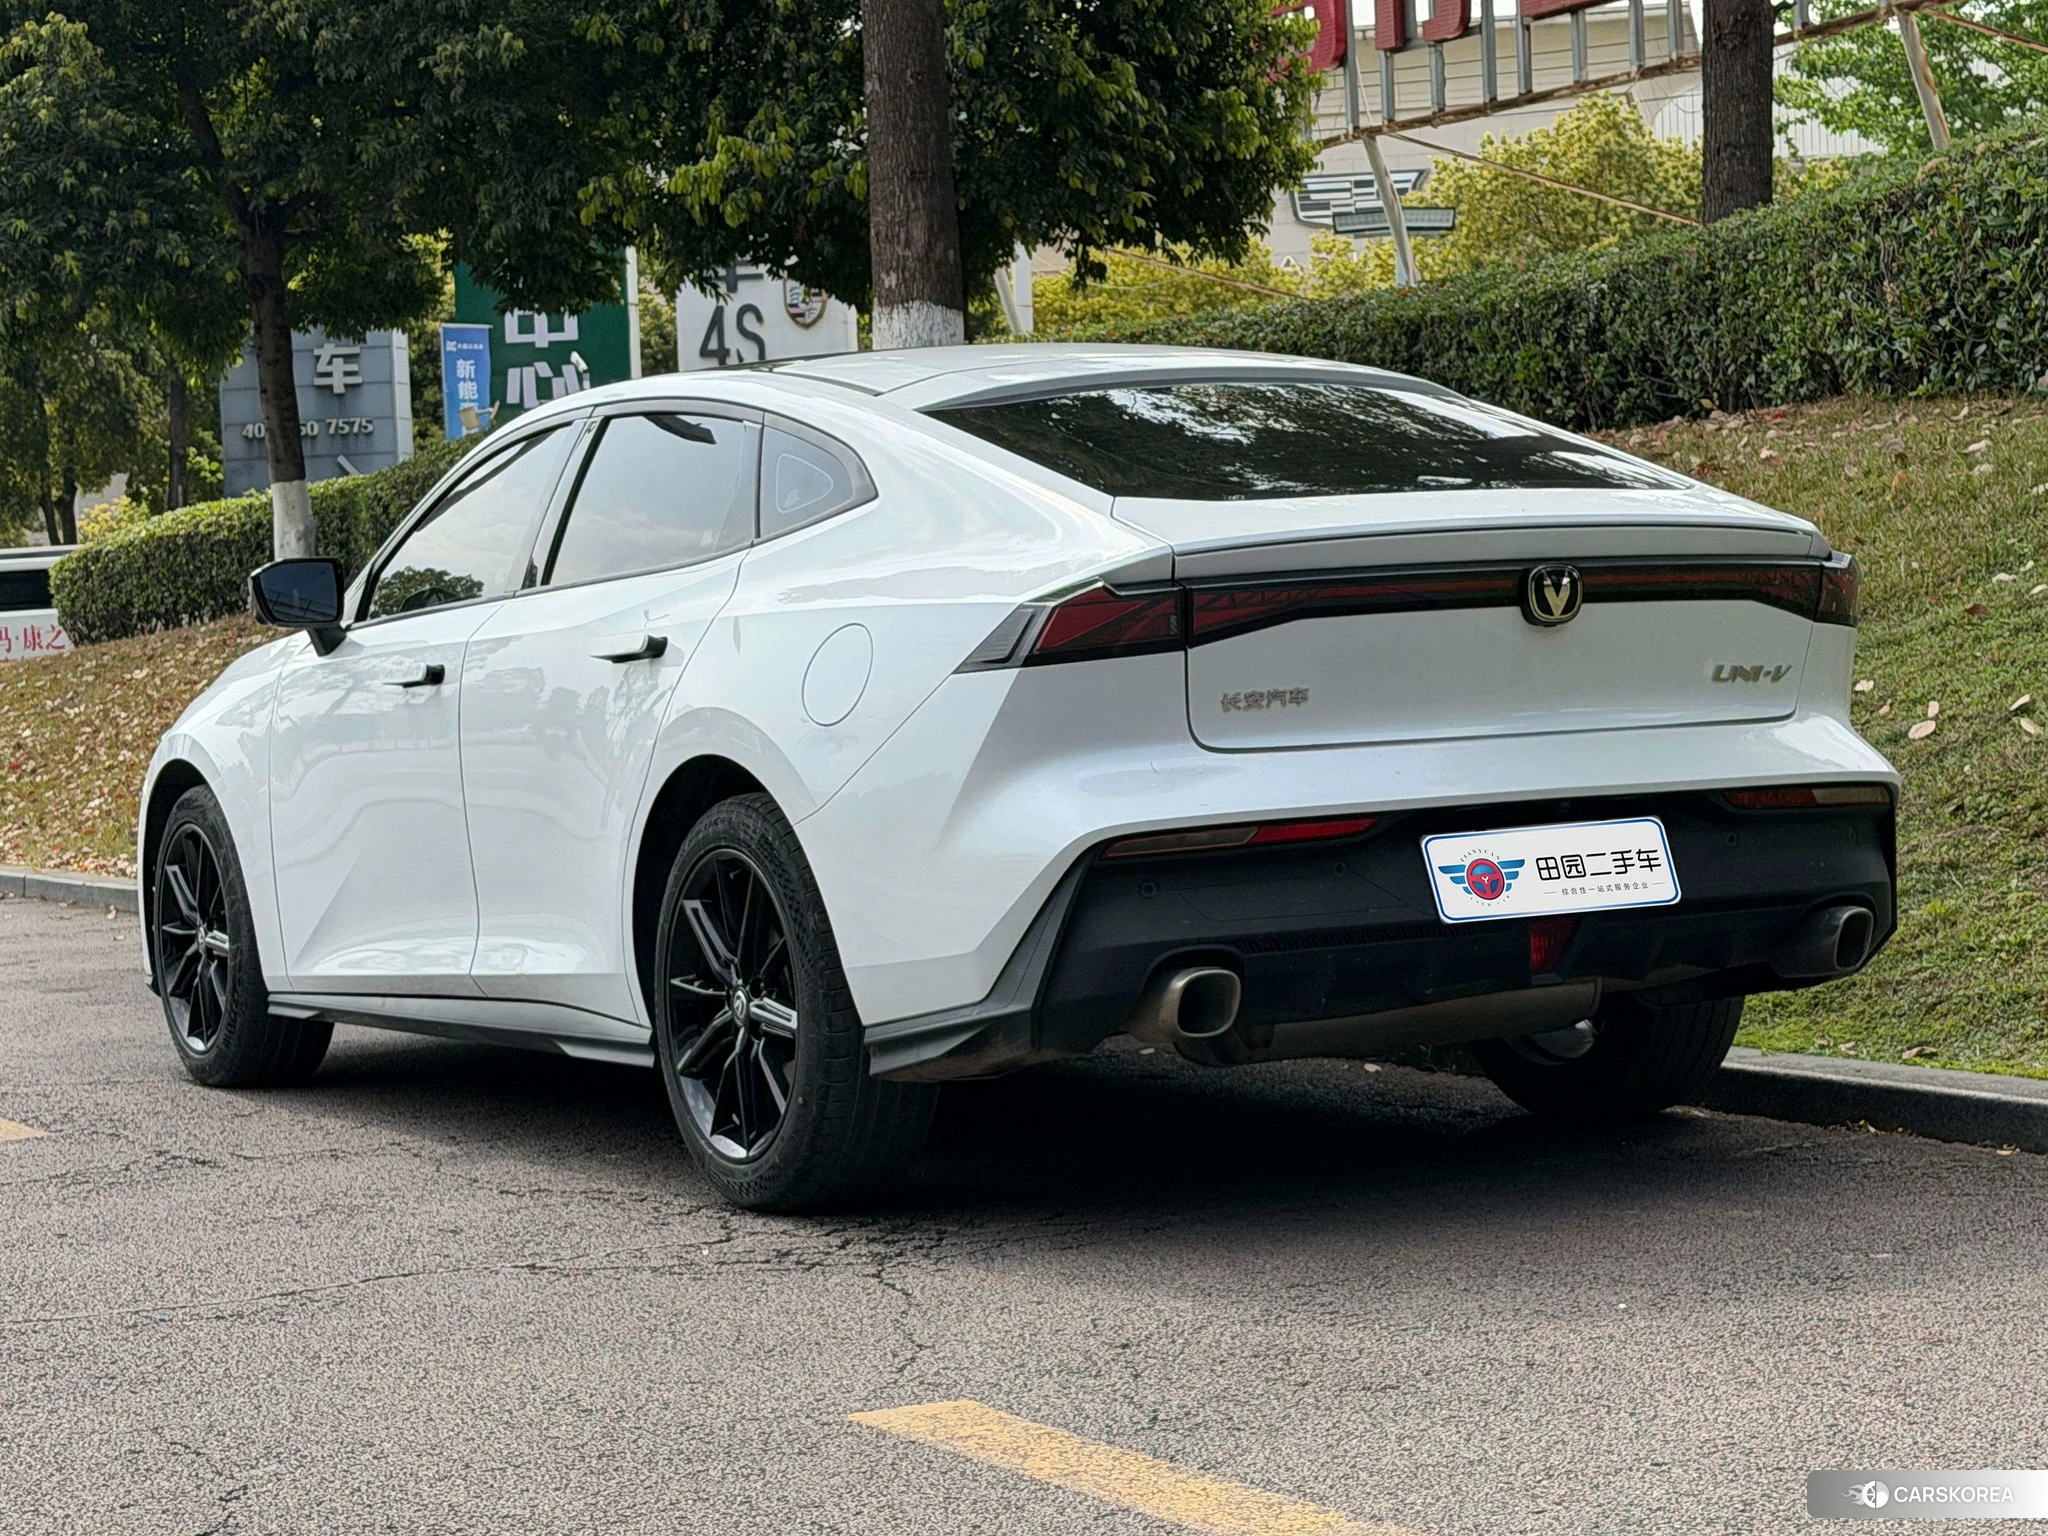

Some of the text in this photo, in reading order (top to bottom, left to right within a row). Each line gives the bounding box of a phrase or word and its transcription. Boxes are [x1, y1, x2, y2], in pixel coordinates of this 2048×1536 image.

[699, 303, 766, 366] 4S
[313, 342, 364, 394] 车
[504, 305, 580, 409] 中心
[242, 422, 266, 439] 40
[326, 417, 375, 435] 7575
[1712, 664, 1792, 683] UNI-V
[1220, 687, 1310, 712] 长安汽车
[1535, 848, 1662, 881] 田园二手车
[1561, 881, 1649, 896] 综合性一站式服务企业
